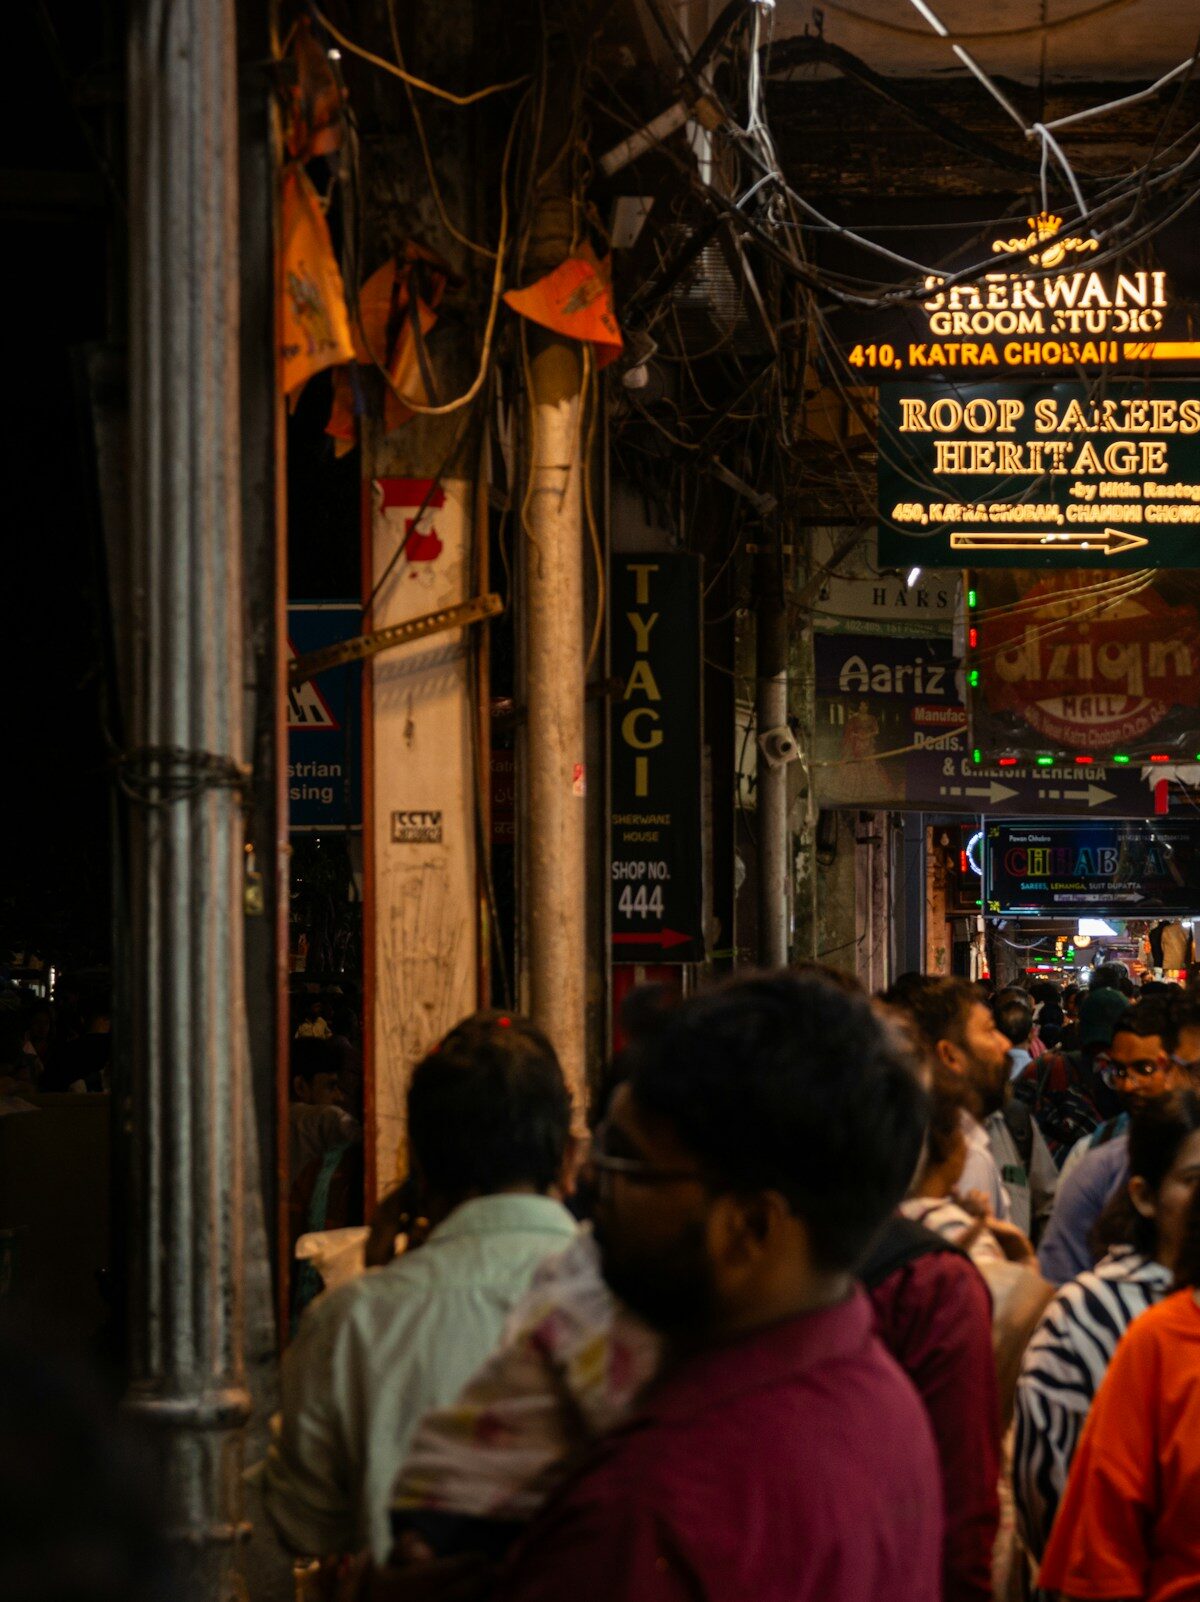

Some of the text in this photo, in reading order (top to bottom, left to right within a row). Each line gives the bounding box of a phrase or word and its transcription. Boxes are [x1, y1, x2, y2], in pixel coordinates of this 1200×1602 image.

[923, 271, 1167, 311] SHERWANI
[930, 309, 1164, 335] GROOM STUDIO
[848, 341, 1119, 370] 410, KATRA CHOBAN
[899, 398, 1025, 433] ROOP
[932, 441, 1168, 474] HERITAGE
[1099, 482, 1141, 498] Nitin
[929, 503, 988, 521] KATRA
[1066, 504, 1142, 522] CHANDNI
[621, 564, 664, 797] TYAGI
[839, 654, 946, 695] Aariz
[1063, 696, 1116, 718] MALL
[942, 757, 955, 777] &
[290, 783, 334, 804] sing
[398, 811, 442, 826] CCTV
[611, 813, 671, 825] SHERWANI
[623, 830, 660, 842] HOUSE
[612, 860, 671, 880] SHOP NO.
[1004, 847, 1168, 877] CHHABA
[618, 884, 665, 919] 444
